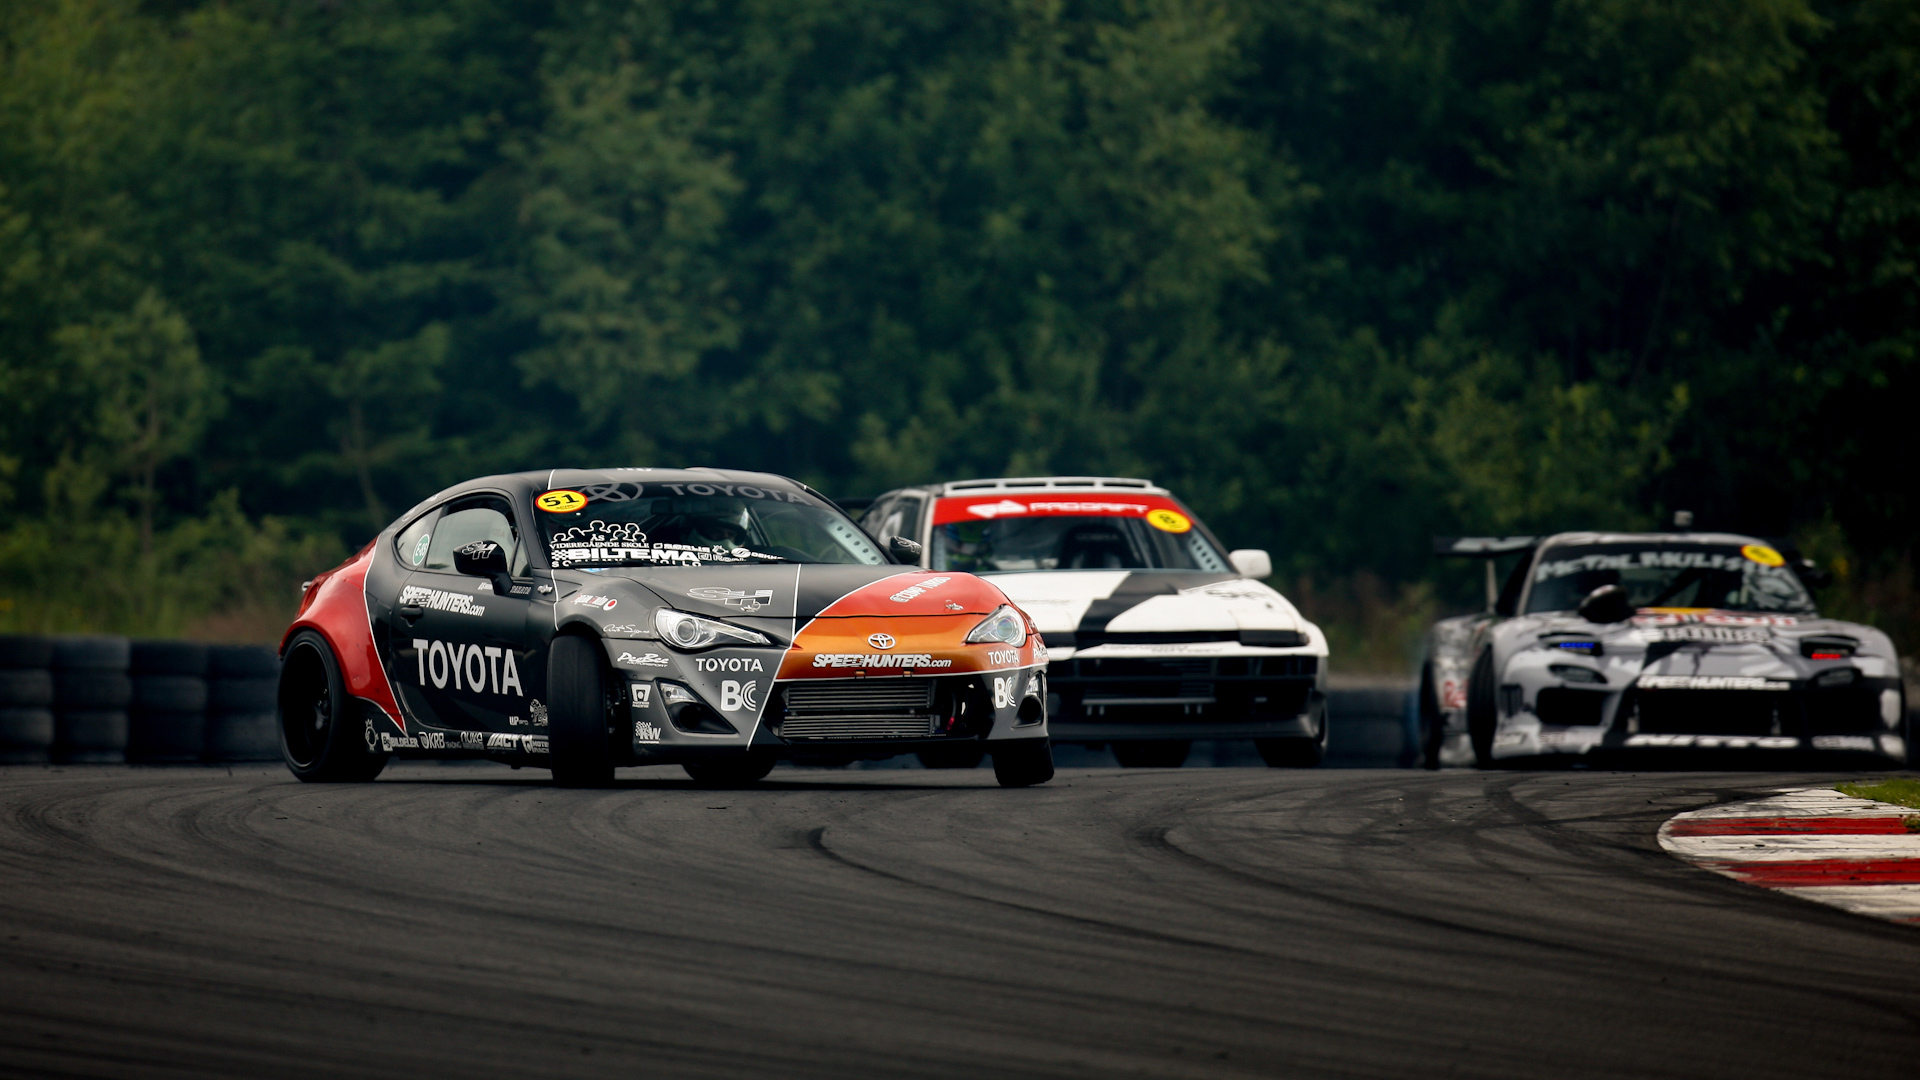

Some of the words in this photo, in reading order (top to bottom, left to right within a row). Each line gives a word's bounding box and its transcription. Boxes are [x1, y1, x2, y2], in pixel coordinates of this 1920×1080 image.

[543, 494, 579, 507] 51
[662, 484, 812, 506] TOYOTA
[1029, 502, 1148, 513] PRODRIFT
[549, 541, 620, 549] VIDEREGÅENDE
[570, 547, 700, 562] BILTEMA
[400, 585, 486, 616] SPEEDHUNTERS.com
[812, 653, 952, 668] SPEEDHUNTERS.com
[988, 649, 1020, 665] TOYOTA
[413, 638, 523, 697] TOYOTA
[696, 658, 763, 672] TOYOTA
[390, 737, 420, 748] BILDELER
[428, 732, 446, 749] KRB
